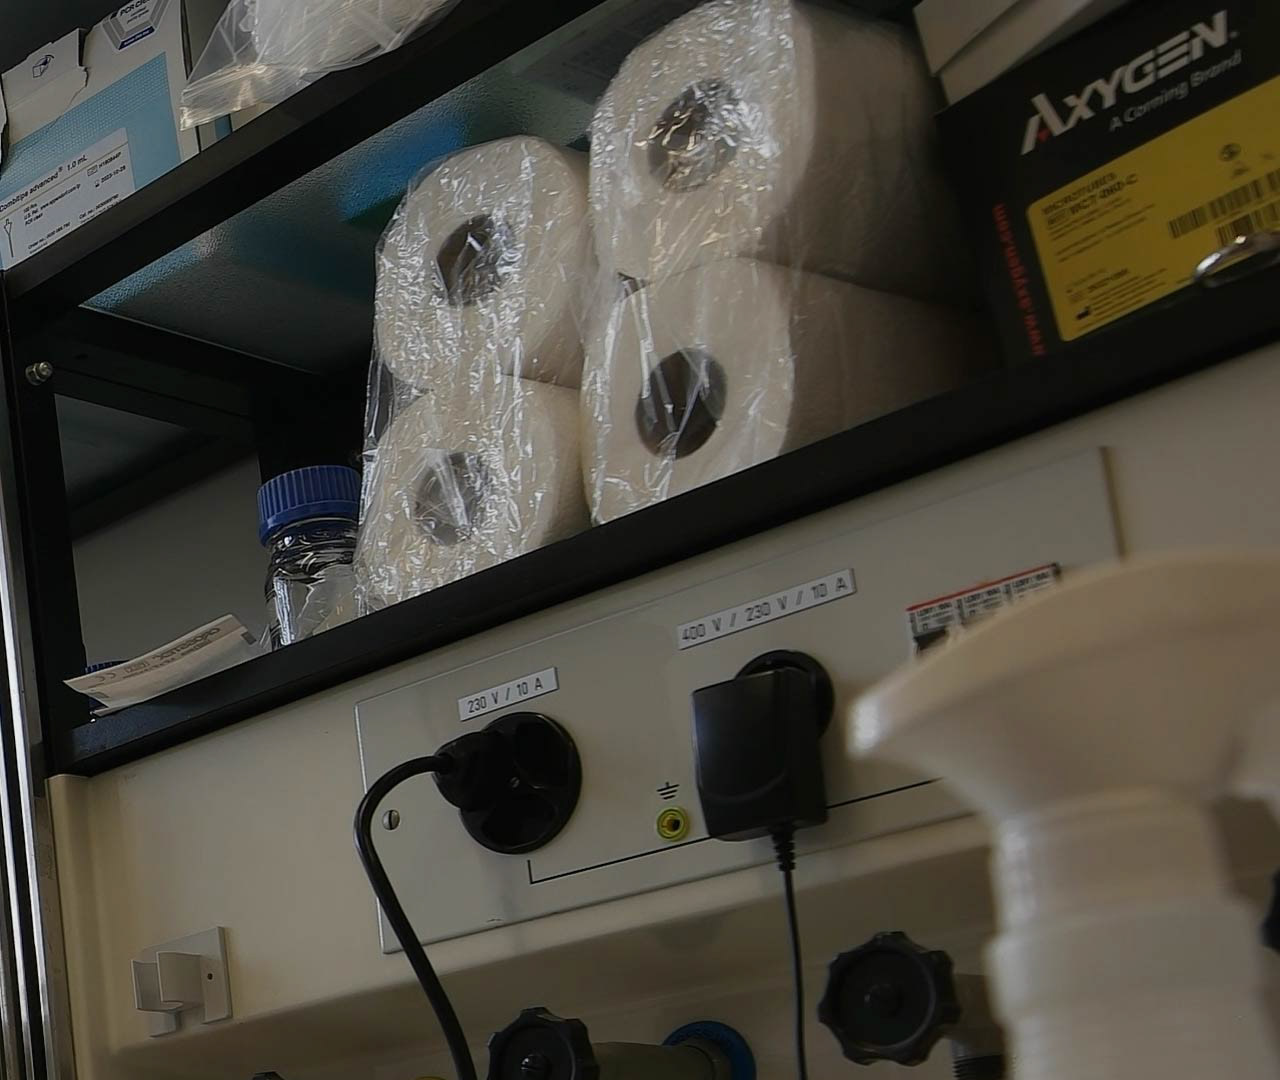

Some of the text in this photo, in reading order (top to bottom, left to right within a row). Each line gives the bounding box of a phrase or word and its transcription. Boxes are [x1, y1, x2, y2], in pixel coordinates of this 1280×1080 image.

[1123, 81, 1189, 123] Corning
[1191, 49, 1242, 87] Brand
[682, 623, 706, 640] 400
[711, 617, 721, 632] V
[745, 602, 771, 622] 230
[776, 595, 788, 610] V
[812, 583, 827, 598] 10
[835, 577, 848, 592] A
[468, 696, 487, 713] 230
[491, 692, 498, 705] V
[517, 682, 528, 696] 10
[535, 677, 543, 691] A
